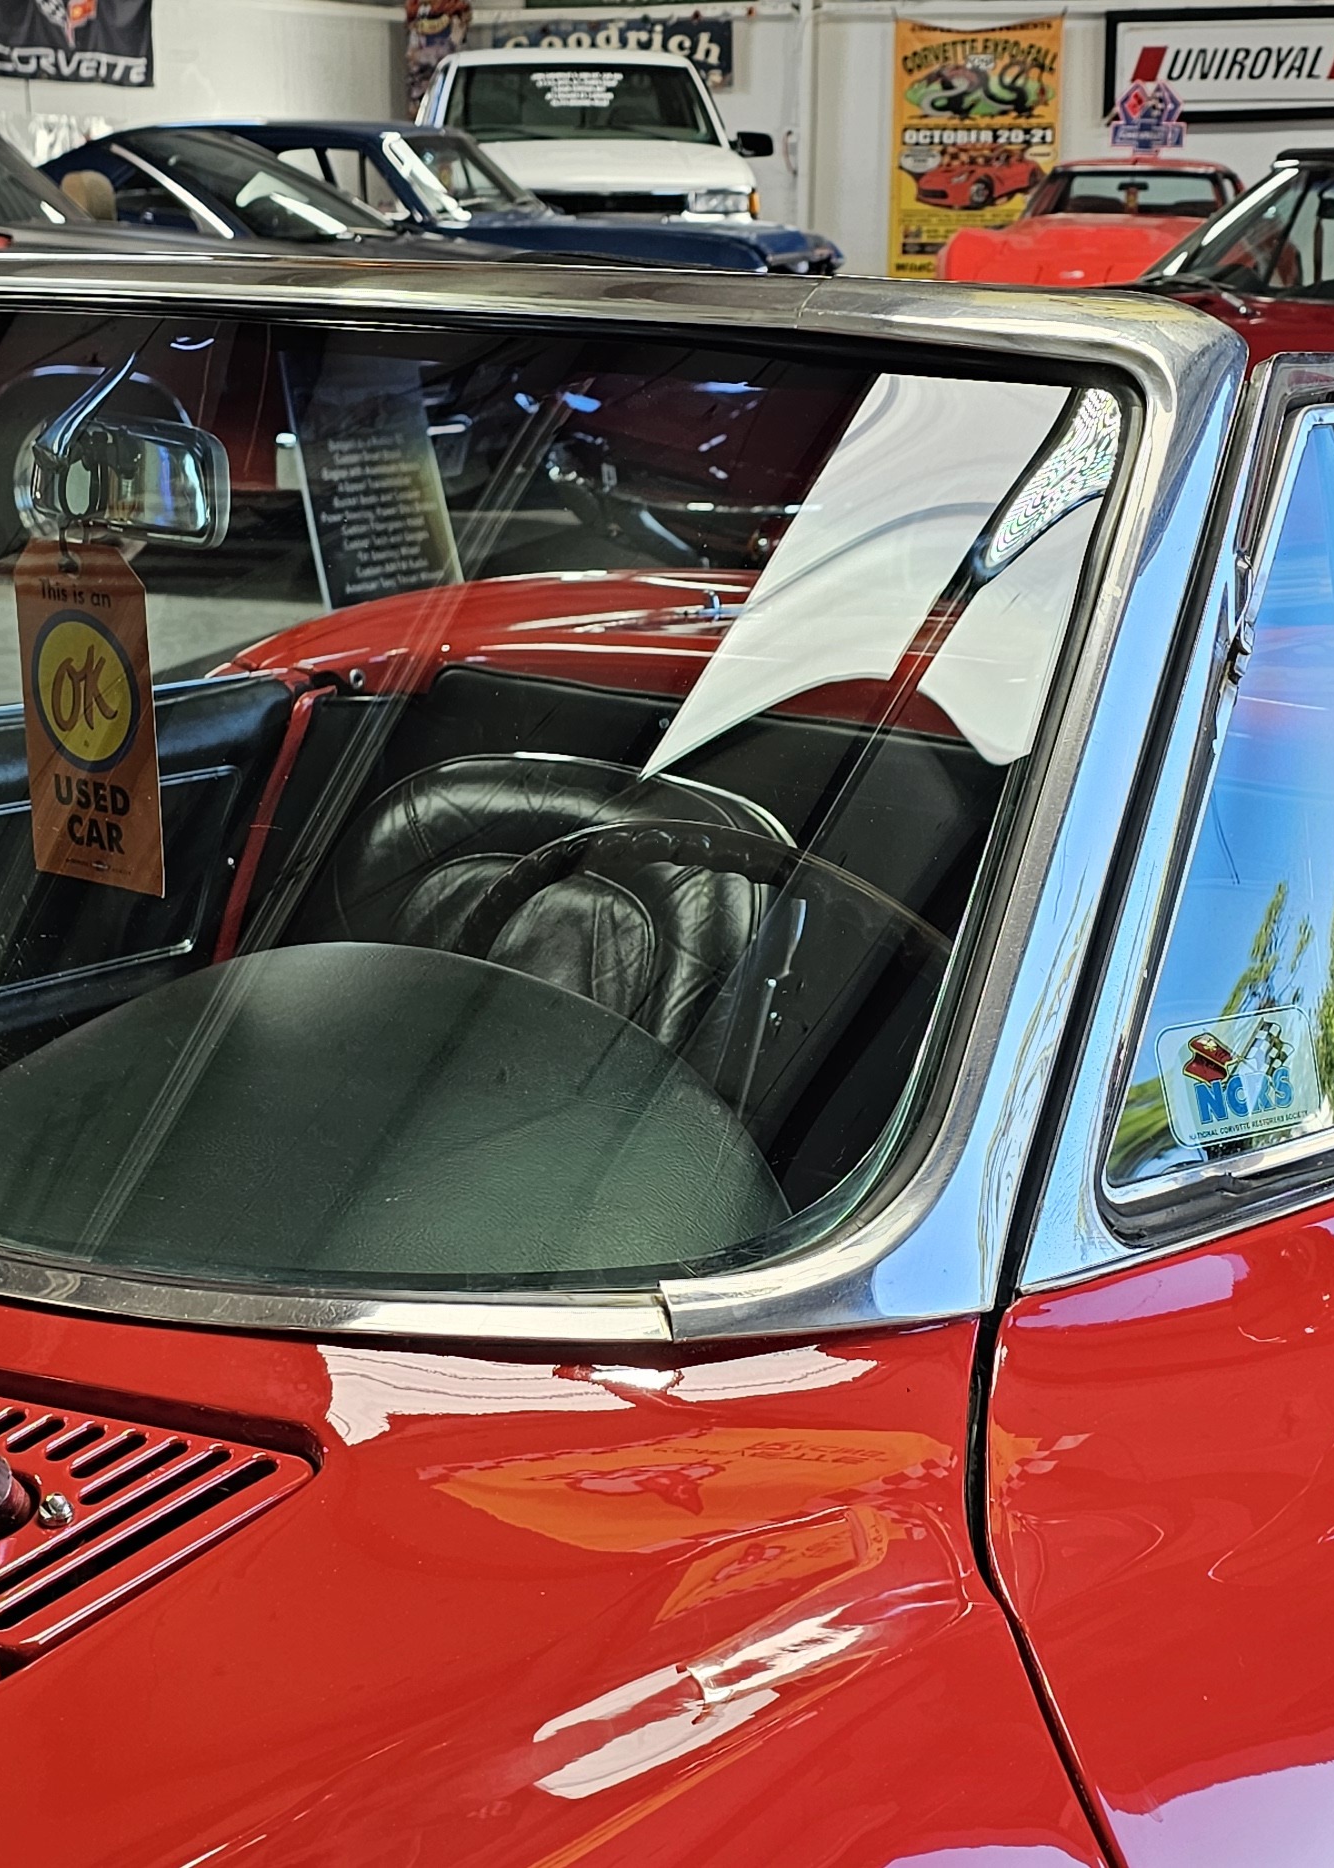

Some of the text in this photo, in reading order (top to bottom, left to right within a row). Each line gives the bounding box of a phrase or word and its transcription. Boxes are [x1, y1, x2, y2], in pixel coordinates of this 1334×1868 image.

[902, 37, 978, 75] CORVETTE
[1166, 46, 1324, 81] UNIROYAL
[903, 128, 1054, 143] OCTOBER 20-21
[39, 578, 112, 608] This is an
[51, 645, 118, 731] OK
[54, 774, 130, 817] USED
[67, 815, 125, 855] CAR
[1194, 1066, 1294, 1124] NCRS
[1219, 1122, 1251, 1135] CORVETTE
